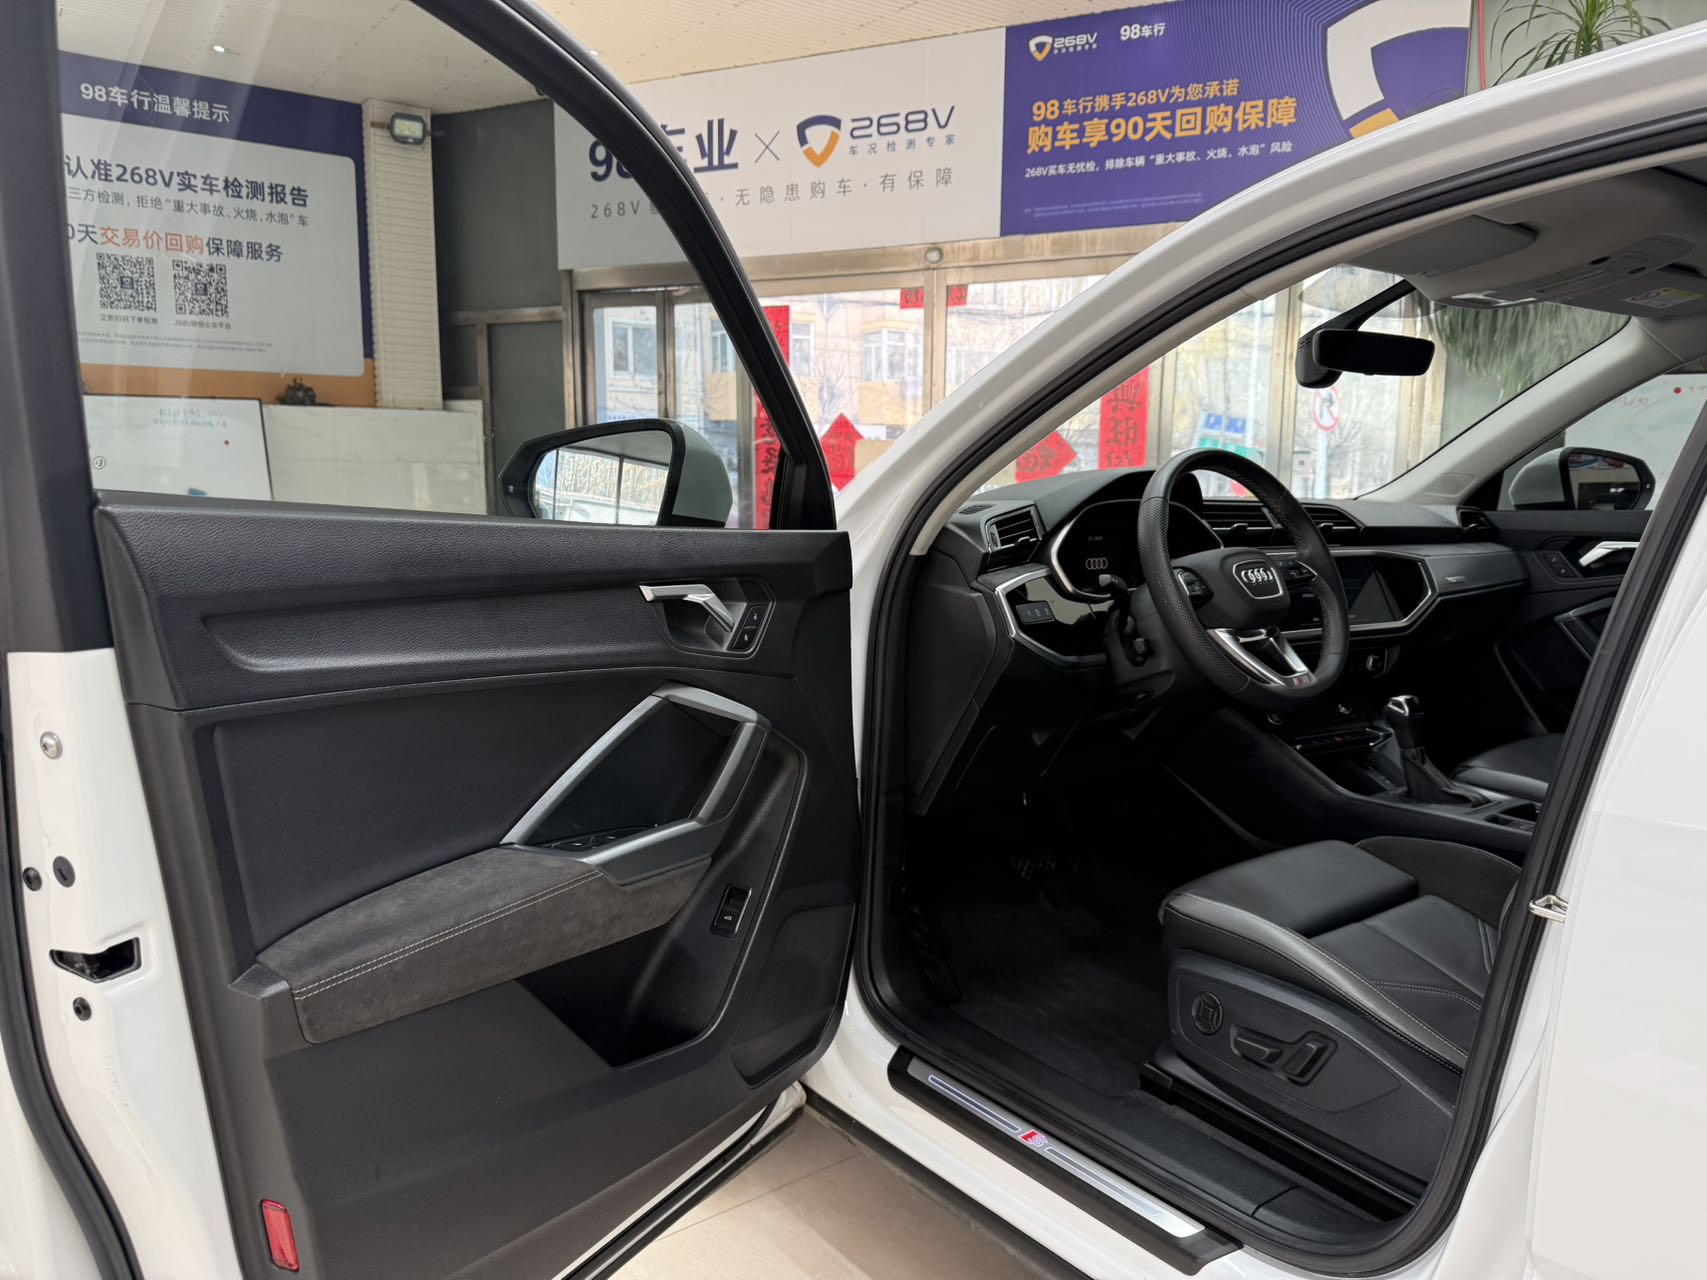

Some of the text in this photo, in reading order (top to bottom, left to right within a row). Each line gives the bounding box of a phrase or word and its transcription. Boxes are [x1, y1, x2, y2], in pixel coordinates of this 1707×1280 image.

[1053, 32, 1098, 48] 268V
[1120, 22, 1166, 40] 98车行
[80, 82, 230, 123] 98车行温馨提示
[849, 105, 956, 140] 268V
[1026, 95, 1297, 154] 购车享90天回购保障
[849, 133, 956, 157] 车况检测专家
